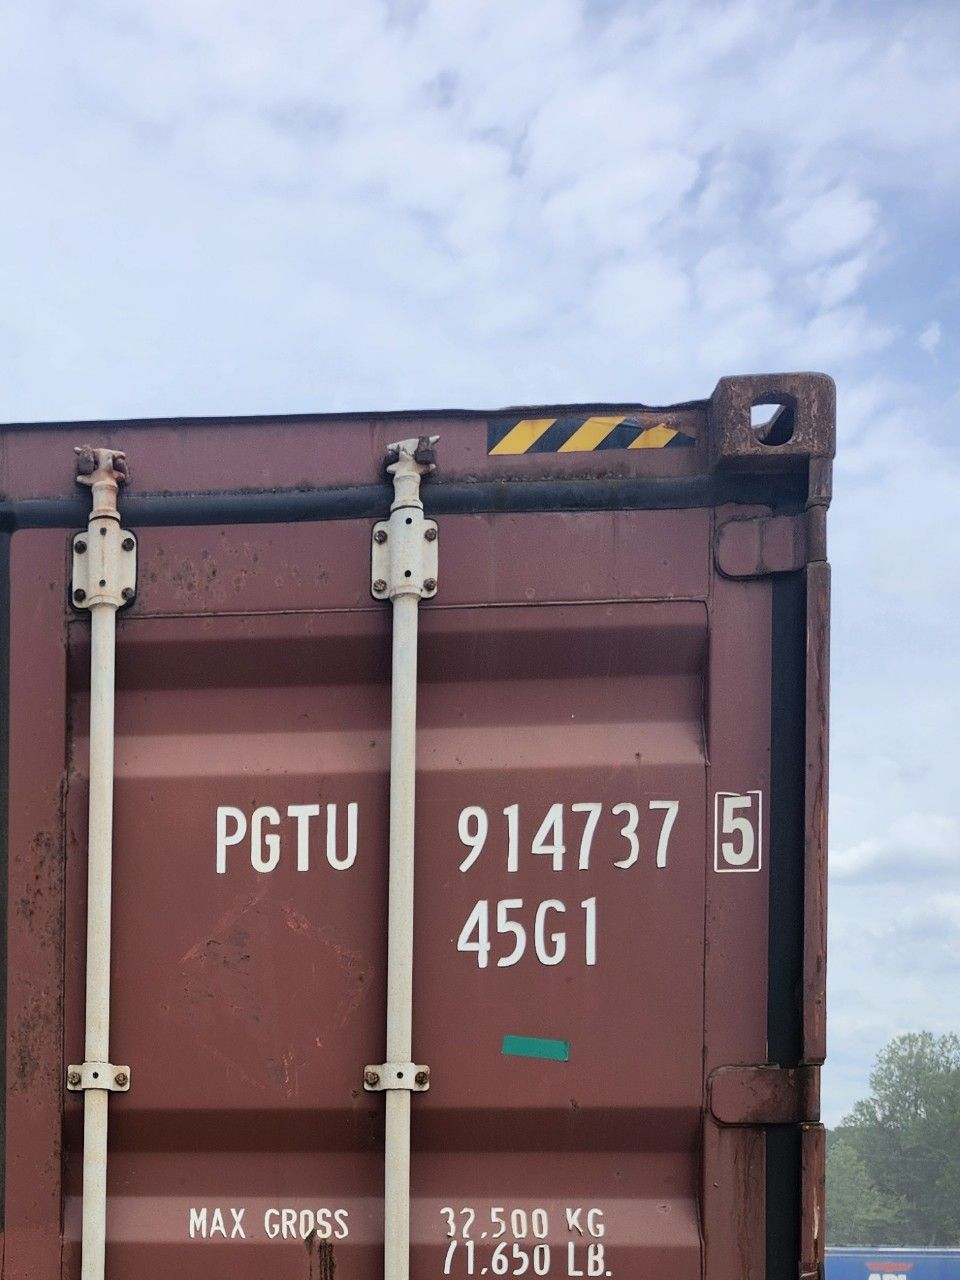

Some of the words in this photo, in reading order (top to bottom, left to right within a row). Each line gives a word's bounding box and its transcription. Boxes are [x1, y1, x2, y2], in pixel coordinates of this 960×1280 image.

[216, 803, 358, 874] PGTU
[458, 801, 680, 872] 914737
[721, 796, 755, 866] 5
[457, 897, 597, 968] 45G1
[190, 1207, 246, 1239] MAX
[264, 1208, 349, 1239] GROSS
[440, 1207, 549, 1239] 32,500
[566, 1207, 605, 1238] KG
[443, 1240, 551, 1276] 71,650
[567, 1241, 612, 1277] LB.
